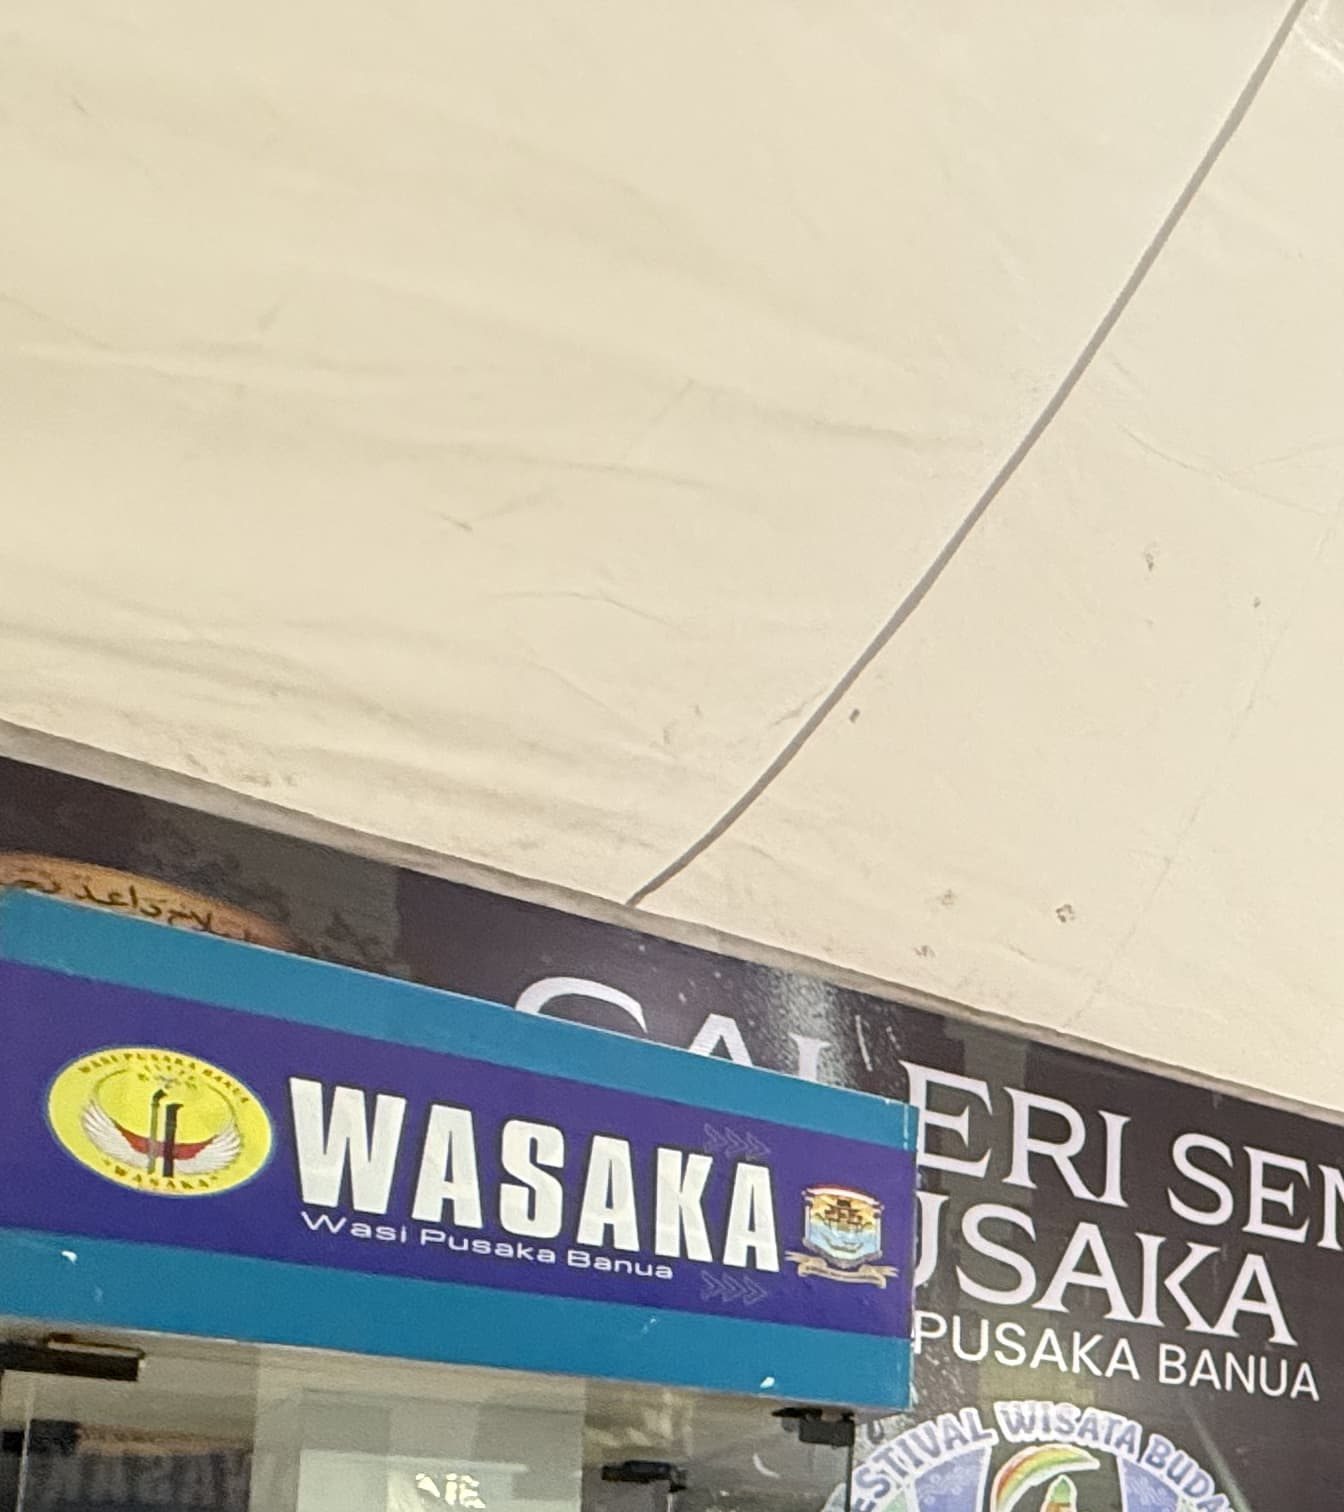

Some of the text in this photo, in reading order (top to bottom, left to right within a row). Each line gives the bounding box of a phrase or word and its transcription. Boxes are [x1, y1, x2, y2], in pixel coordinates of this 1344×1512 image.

[289, 1077, 780, 1273] WASAKA
[300, 1211, 674, 1280] Wasi Pusaka Banua
[914, 1309, 1320, 1402] PUSAKA BANUA
[997, 1402, 1141, 1459] WISATA
